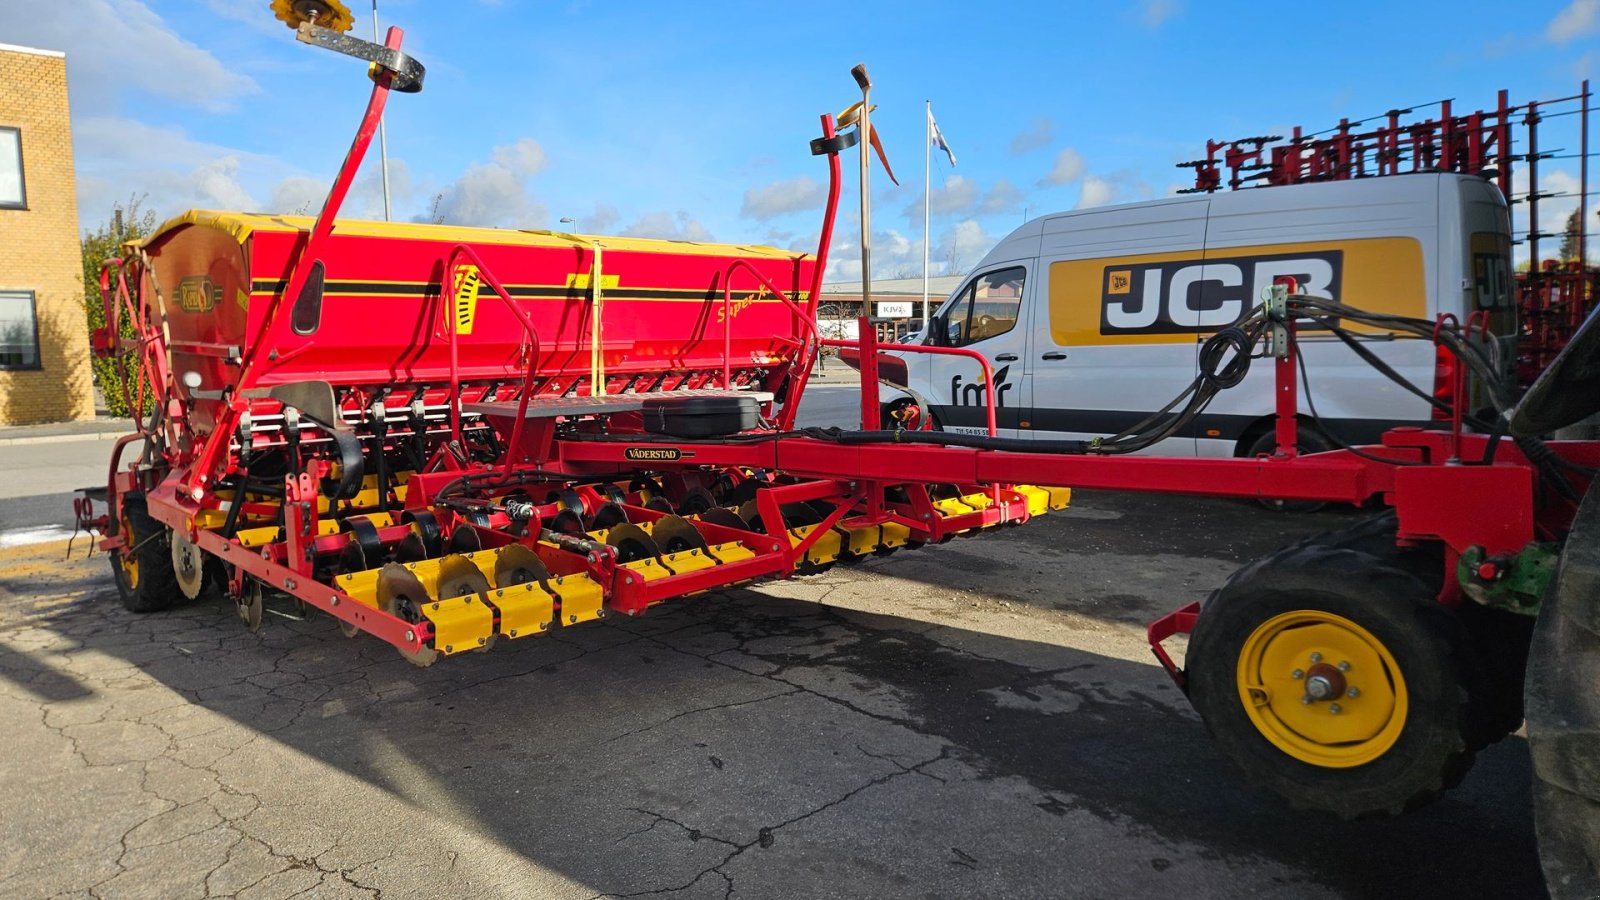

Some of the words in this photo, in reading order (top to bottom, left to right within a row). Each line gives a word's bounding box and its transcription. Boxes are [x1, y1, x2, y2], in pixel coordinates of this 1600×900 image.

[1106, 258, 1334, 328] JCB
[717, 294, 755, 323] Super
[952, 375, 1012, 407] fmr
[629, 449, 676, 459] VÄDERSTAD
